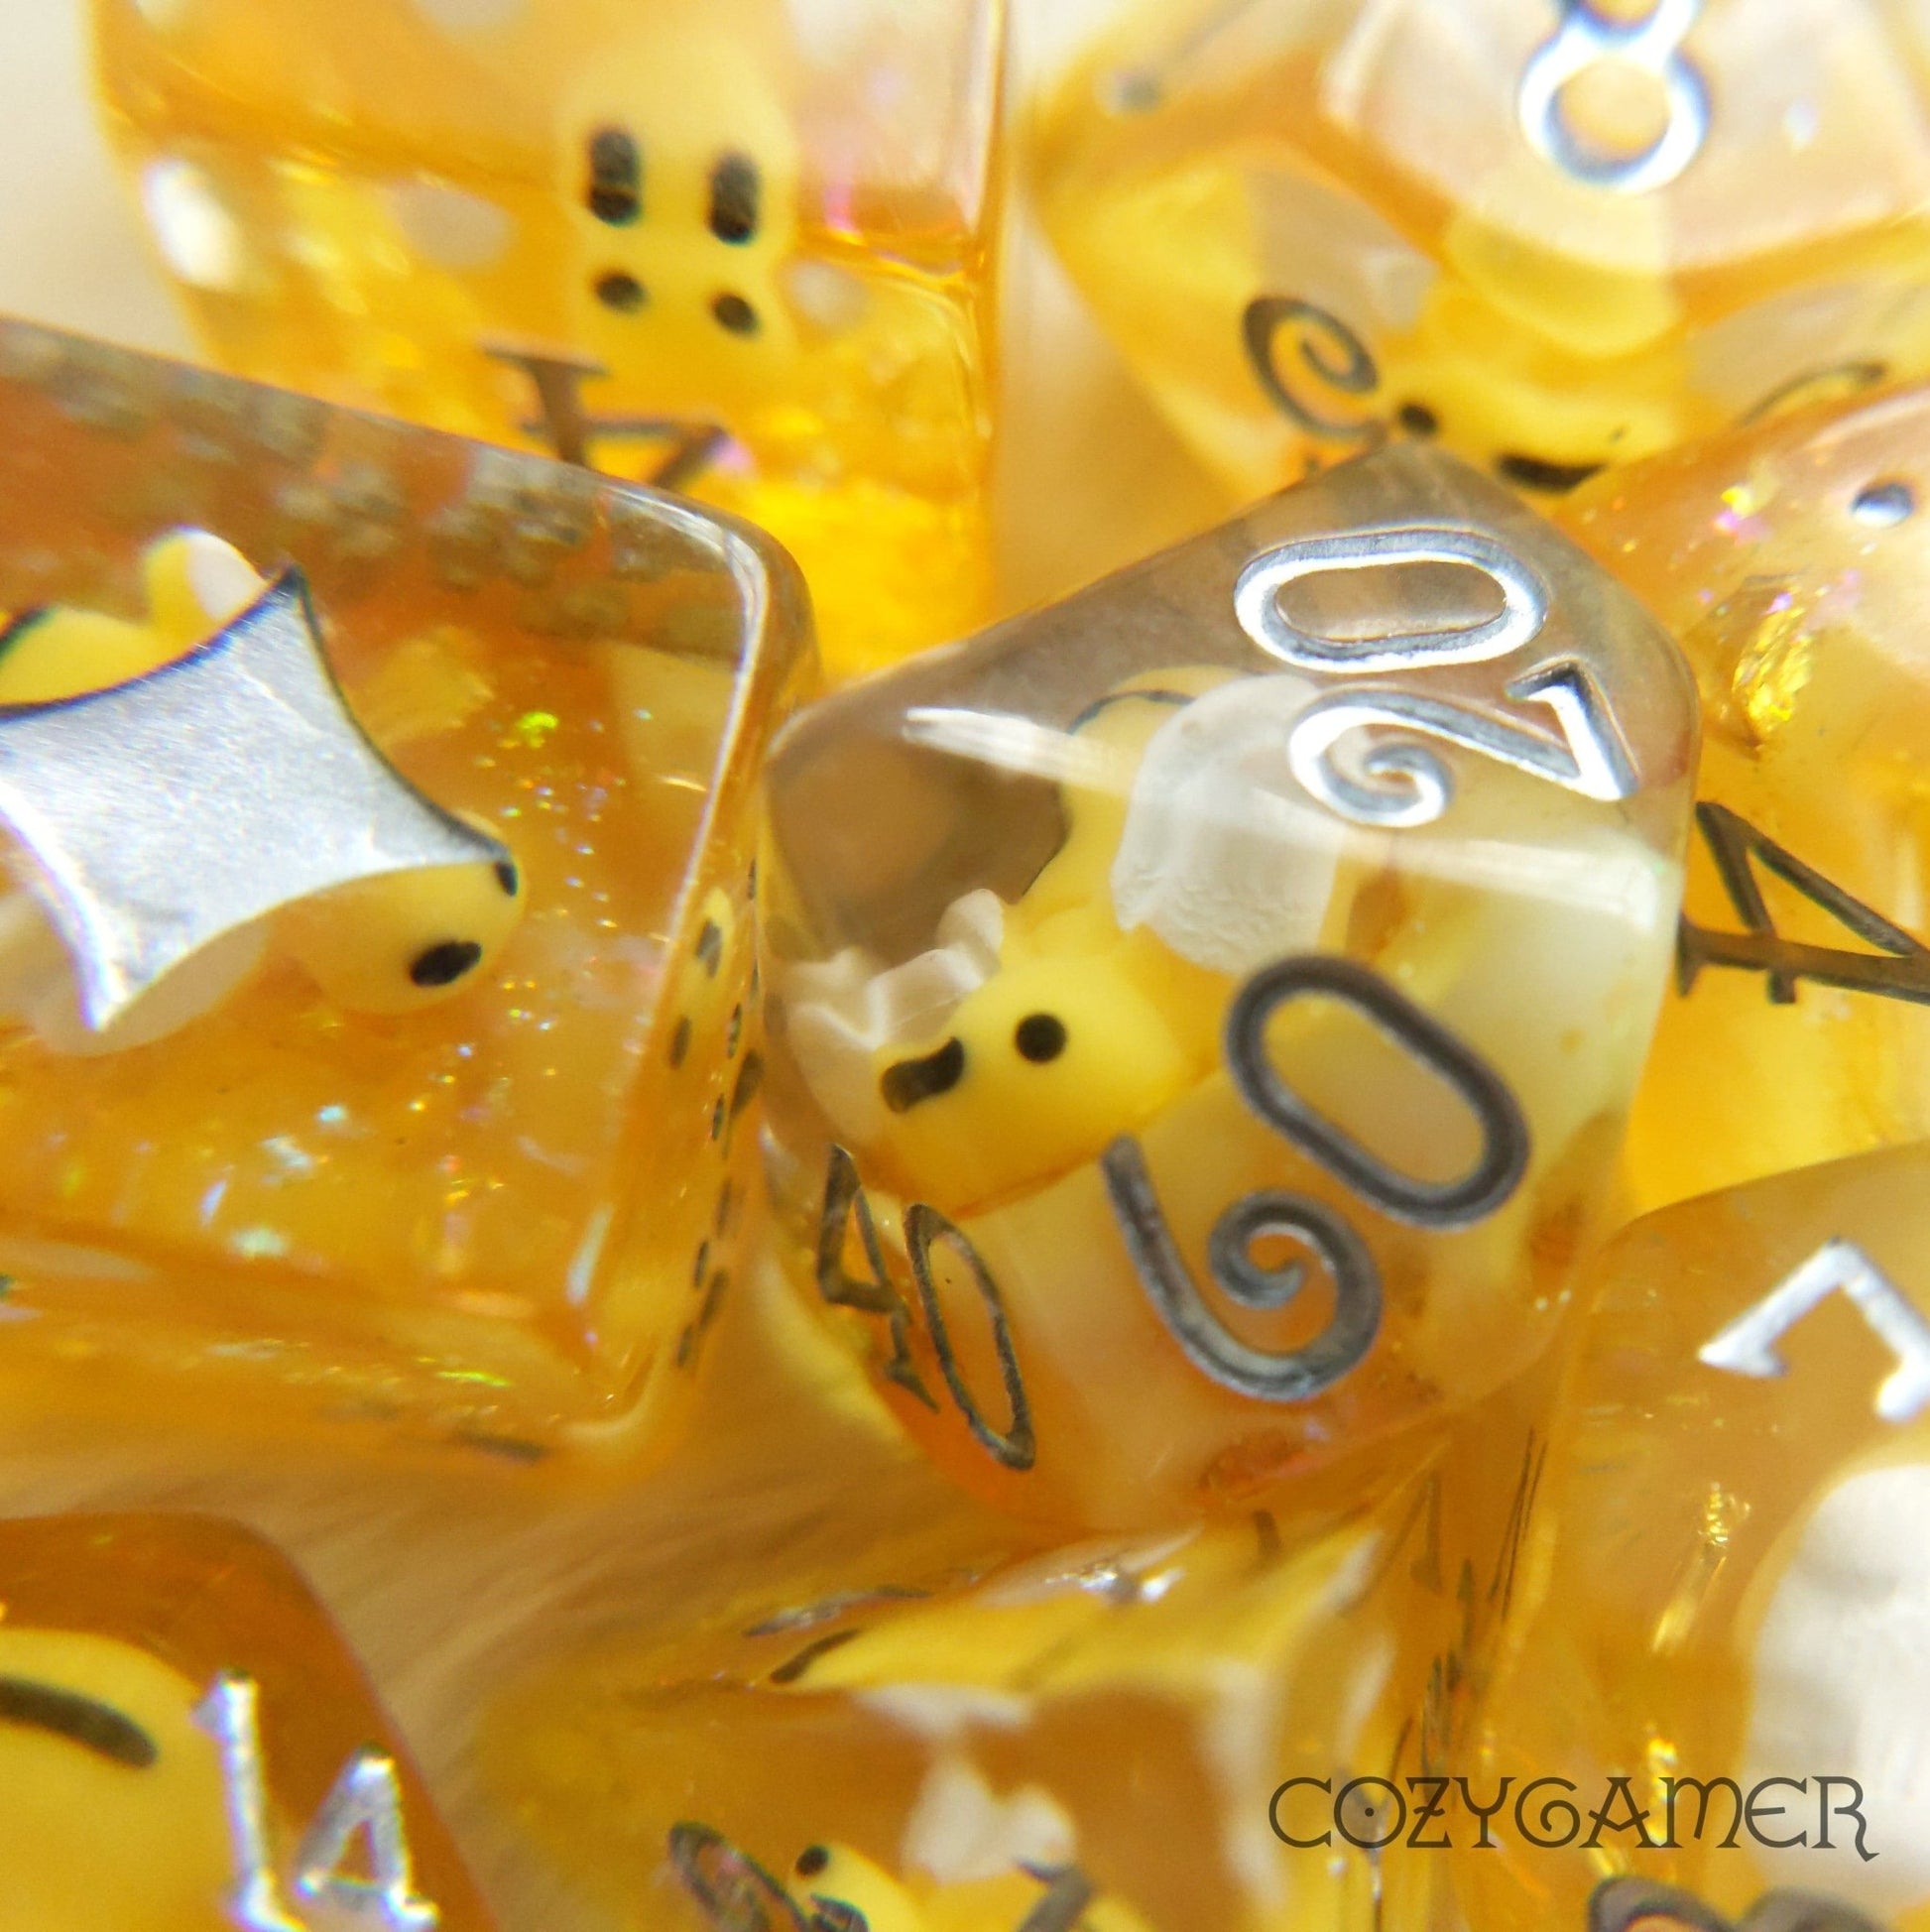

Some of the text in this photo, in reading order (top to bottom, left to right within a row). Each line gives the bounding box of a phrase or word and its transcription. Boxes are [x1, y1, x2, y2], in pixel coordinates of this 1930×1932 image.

[1233, 524, 1640, 829] 20
[816, 1143, 1036, 1471] 40
[1102, 954, 1530, 1401] 60
[188, 1668, 439, 1932] 14
